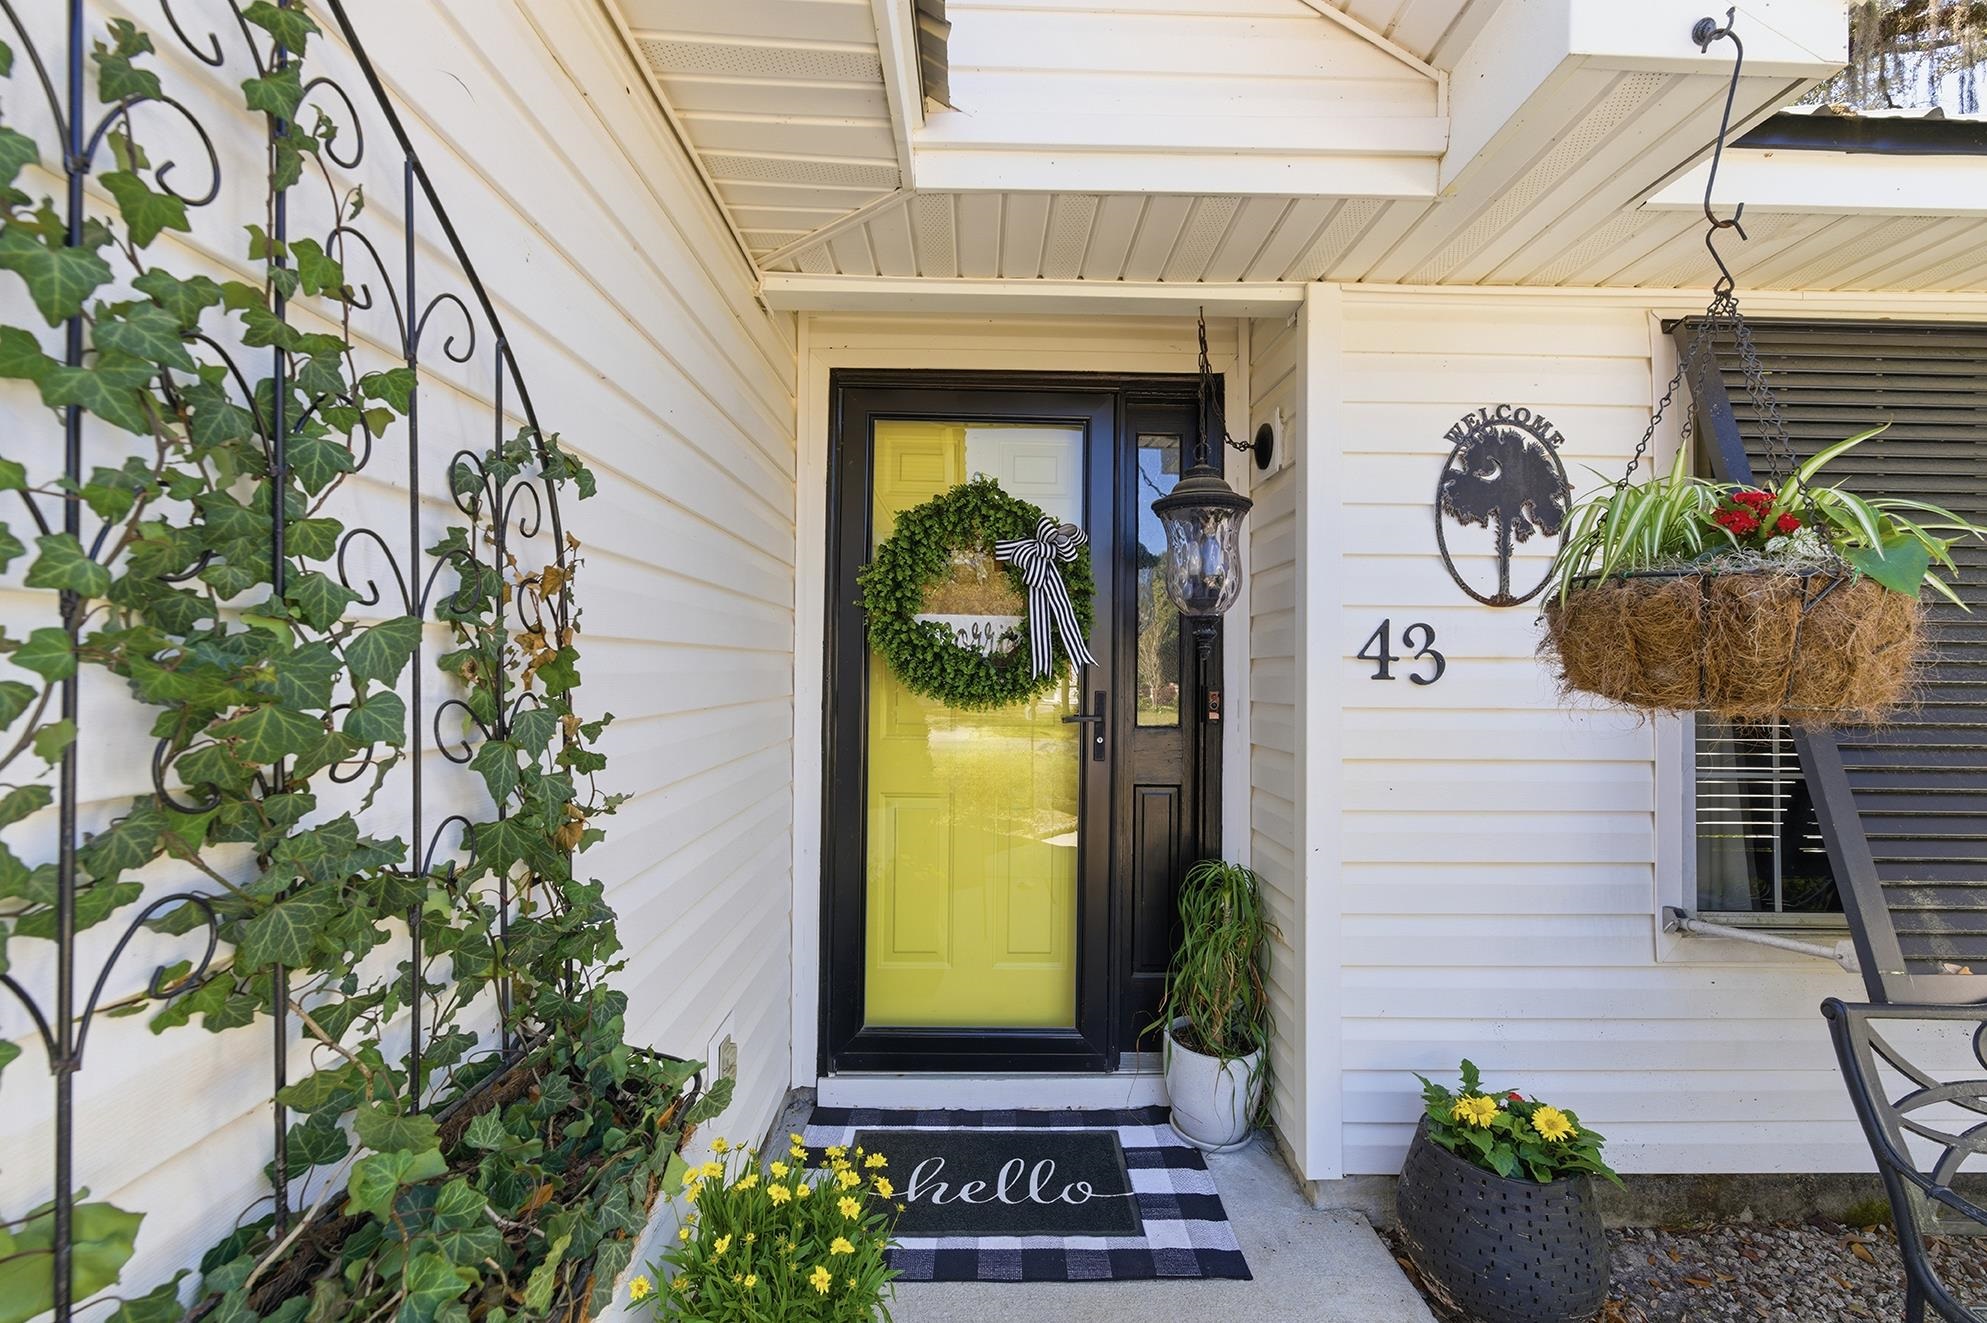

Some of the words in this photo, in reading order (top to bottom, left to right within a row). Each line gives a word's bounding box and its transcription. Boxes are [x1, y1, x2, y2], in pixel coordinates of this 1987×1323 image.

[1443, 404, 1565, 449] WELCOME
[1357, 618, 1446, 685] 43
[869, 1157, 1134, 1205] hello
